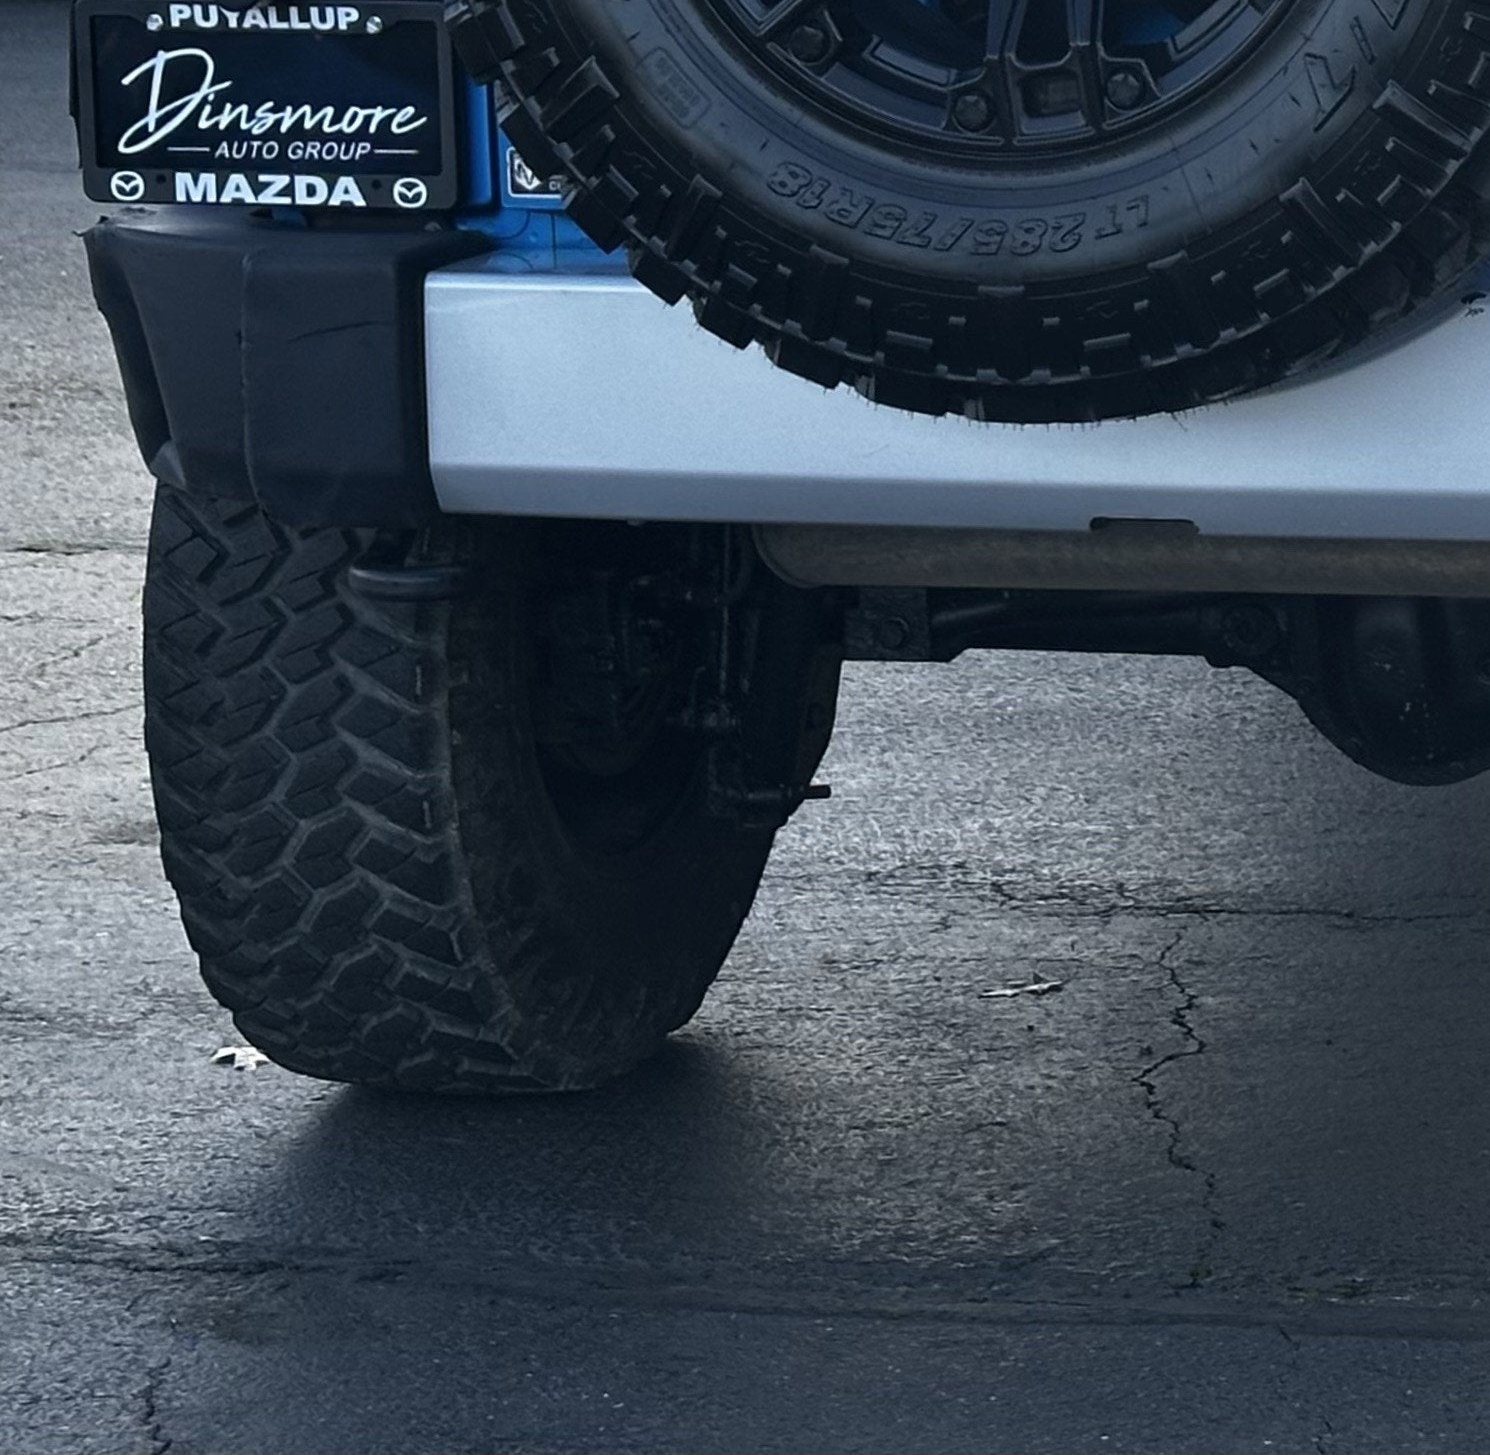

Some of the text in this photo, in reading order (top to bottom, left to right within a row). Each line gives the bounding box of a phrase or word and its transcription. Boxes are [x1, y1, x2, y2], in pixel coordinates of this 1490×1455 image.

[169, 3, 360, 31] PUYALLUP
[117, 48, 427, 154] Dinsmore
[214, 141, 371, 161] AUTO GROUP
[174, 171, 367, 207] MAZDA
[765, 160, 1087, 257] 285/75R18
